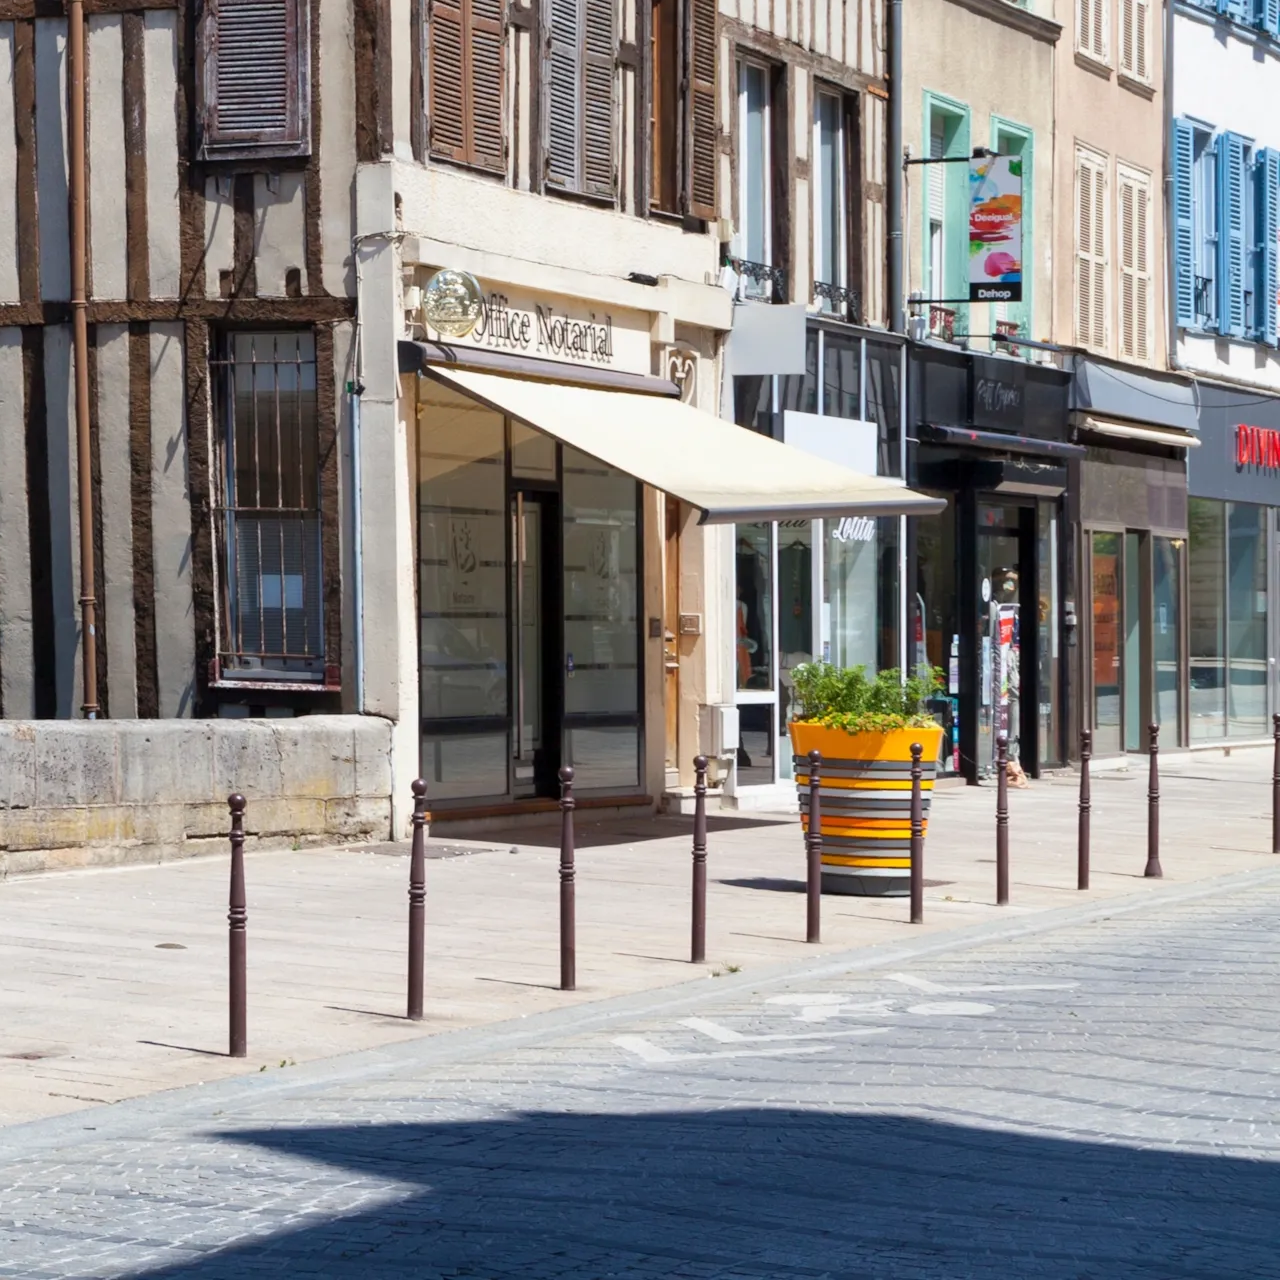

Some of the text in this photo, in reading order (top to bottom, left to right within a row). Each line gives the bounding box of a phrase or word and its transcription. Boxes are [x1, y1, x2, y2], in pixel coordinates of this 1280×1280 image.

[978, 289, 1011, 299] Dehop
[535, 303, 613, 358] Notarial
[832, 516, 876, 543] Lolita
